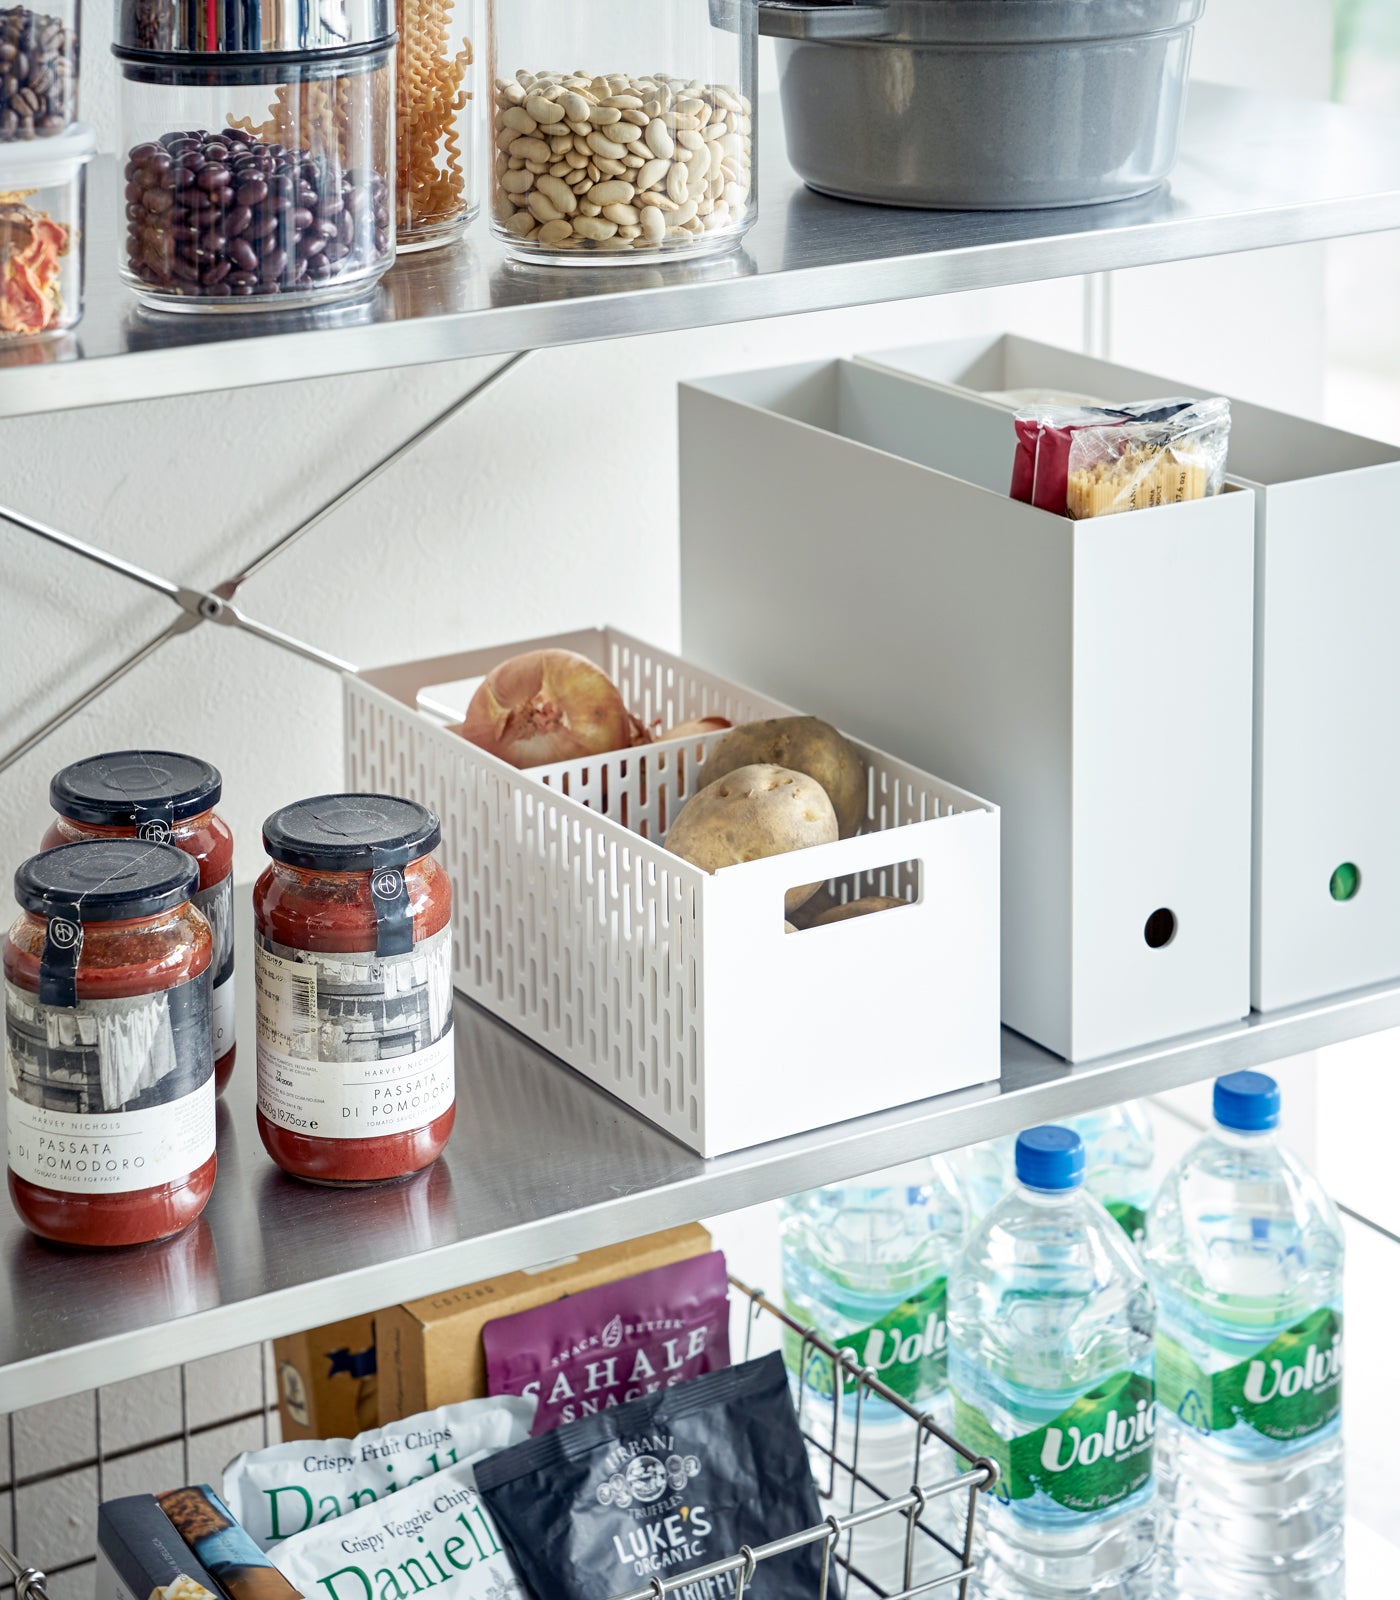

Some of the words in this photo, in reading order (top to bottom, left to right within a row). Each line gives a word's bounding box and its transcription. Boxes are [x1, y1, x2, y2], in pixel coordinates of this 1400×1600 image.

[364, 1066, 402, 1077] HARVEY
[374, 1073, 436, 1100] PASSATA
[342, 1107, 358, 1118] DI
[372, 1077, 450, 1117] POMODORO
[31, 1115, 65, 1128] HARVEY
[71, 1121, 121, 1130] NICHOLS
[18, 1144, 30, 1160] DI
[37, 1153, 146, 1172] POMODORO
[39, 1137, 112, 1155] PASSATA
[59, 1173, 81, 1182] SAUCE
[100, 1174, 121, 1182] PASTA
[551, 1333, 599, 1368] SNACK
[624, 1319, 683, 1335] BETTER
[522, 1325, 708, 1405] SAHALE
[303, 1455, 356, 1474] Crispy
[359, 1438, 402, 1464] Fruit
[405, 1426, 453, 1451] Chips
[606, 1435, 675, 1470] URBANI
[1041, 1399, 1157, 1472] Volvic
[341, 1532, 385, 1555] Crispy
[383, 1509, 434, 1539] Veggie
[433, 1485, 479, 1514] Chips
[627, 1492, 684, 1520] TRUFFLES
[612, 1506, 712, 1565] LUKE'S
[633, 1540, 705, 1577] ORGANIC
